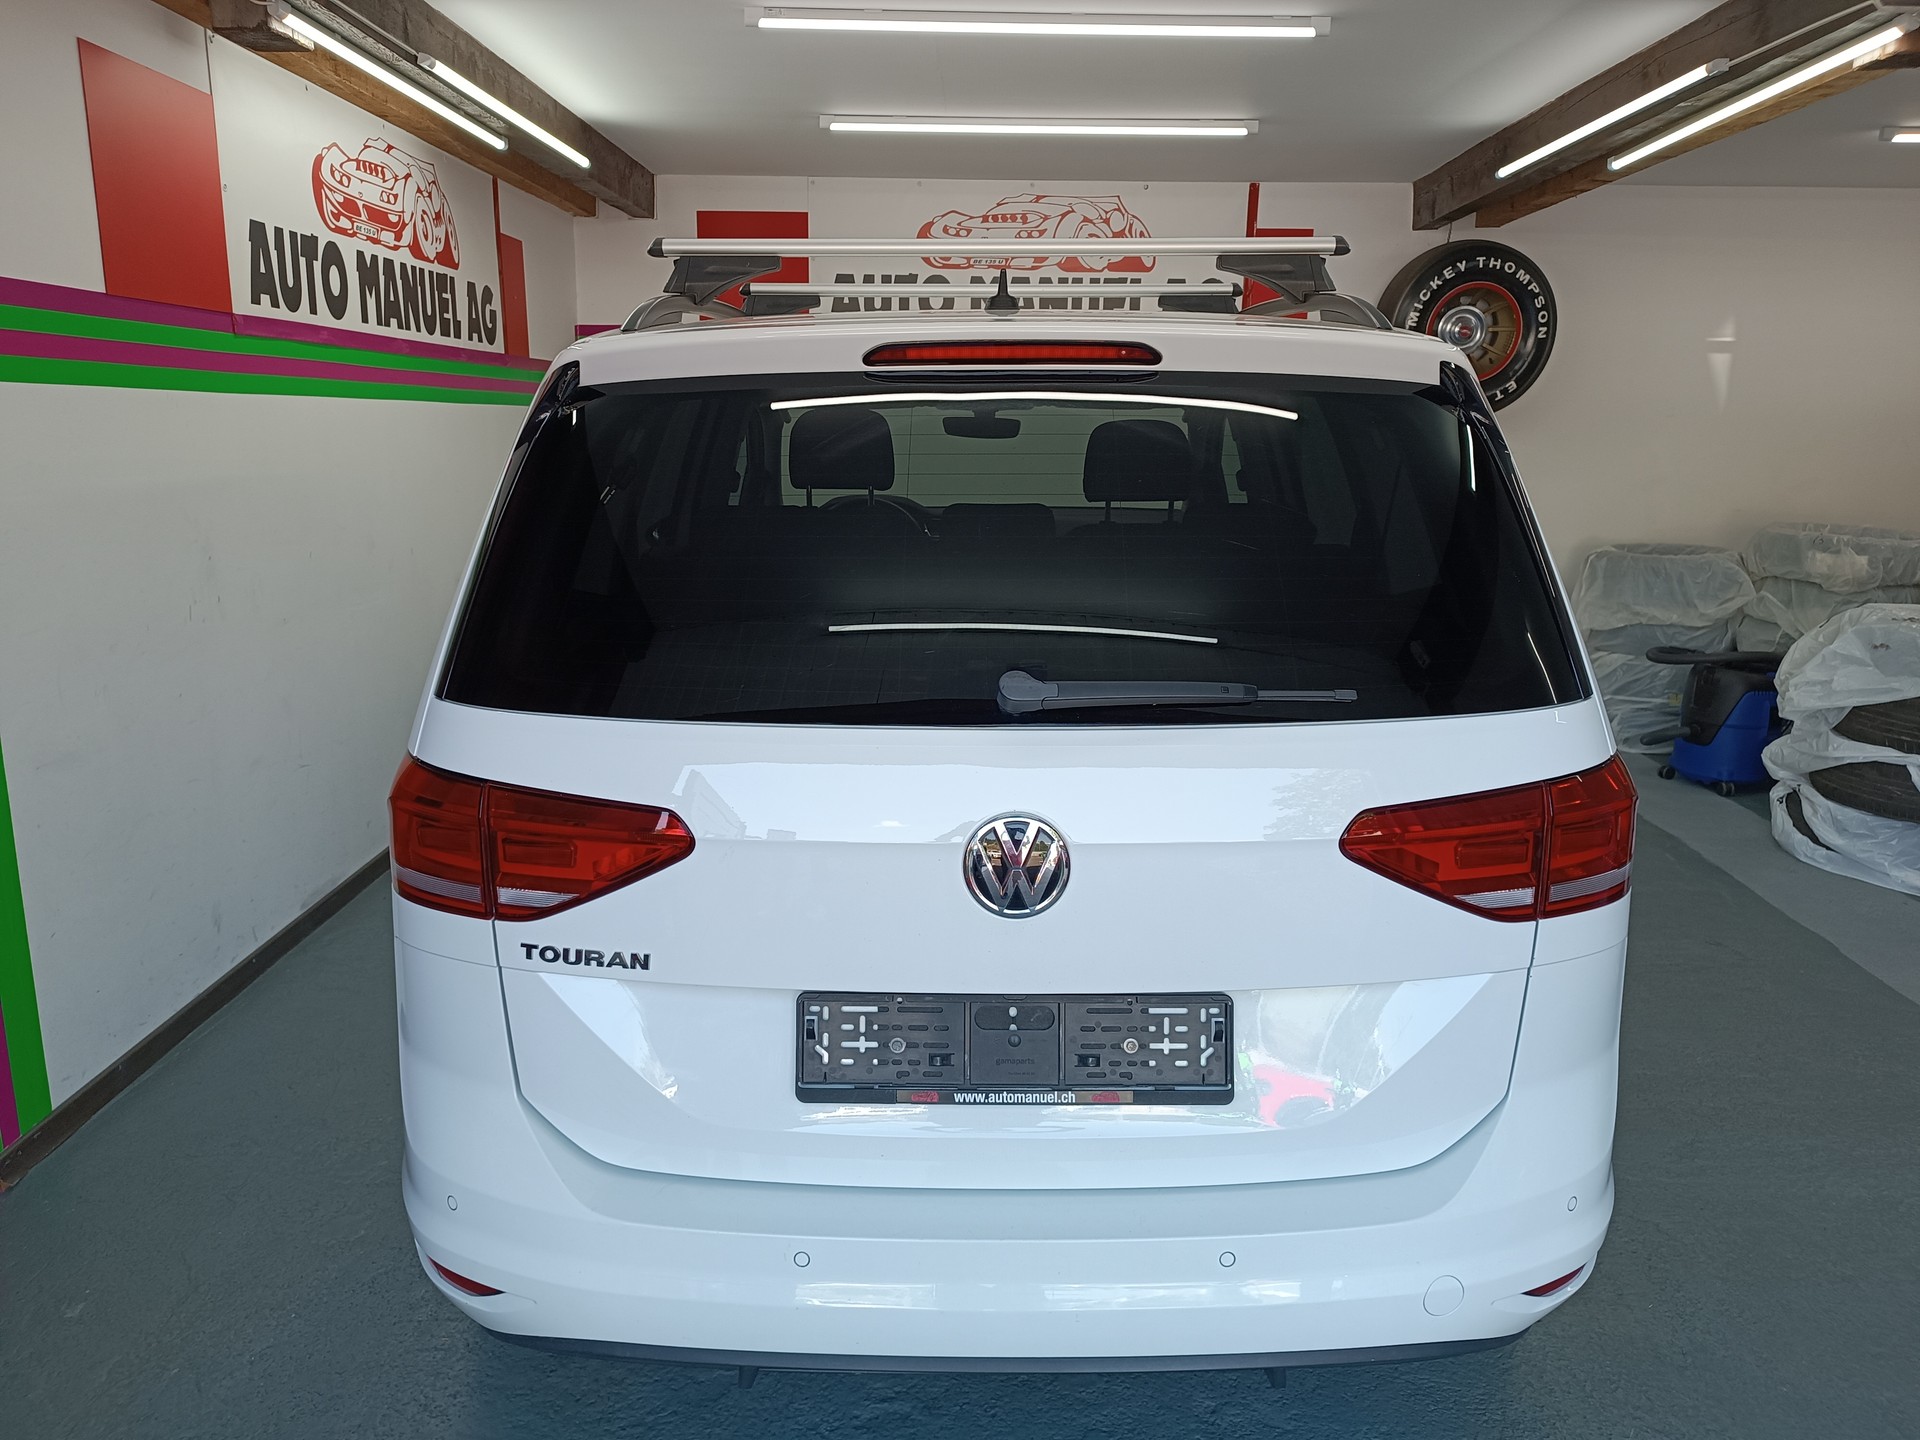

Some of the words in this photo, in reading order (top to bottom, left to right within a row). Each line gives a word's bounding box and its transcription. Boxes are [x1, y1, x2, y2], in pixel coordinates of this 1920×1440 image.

[249, 219, 348, 320] AUTO
[356, 249, 461, 339] MANUEL
[466, 280, 497, 346] AG
[831, 273, 955, 312] AUTO
[1405, 259, 1467, 330] MICKEY
[1476, 256, 1548, 339] THOMPSON
[520, 942, 652, 971] TOURAN
[953, 1090, 1076, 1104] www.automanuel.ch
